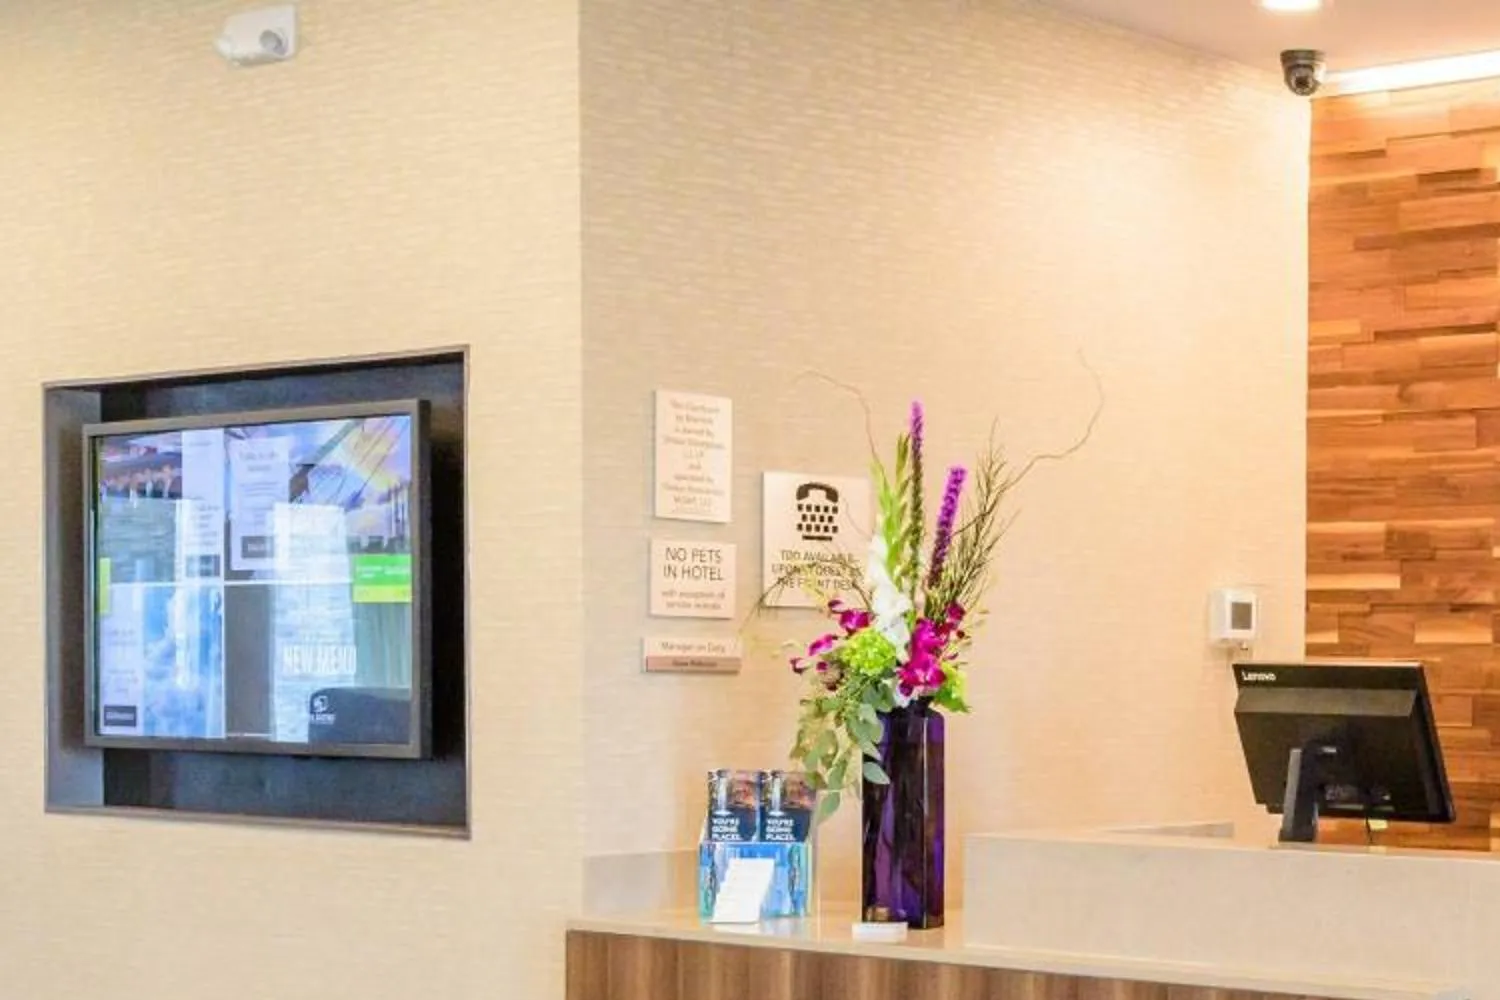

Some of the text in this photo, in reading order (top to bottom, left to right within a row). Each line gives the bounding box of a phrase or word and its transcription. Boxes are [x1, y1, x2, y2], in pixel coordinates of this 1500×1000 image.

[665, 547, 722, 564] NO PETS
[663, 564, 724, 581] IN HOTEL
[1241, 671, 1276, 681] Lenovo
